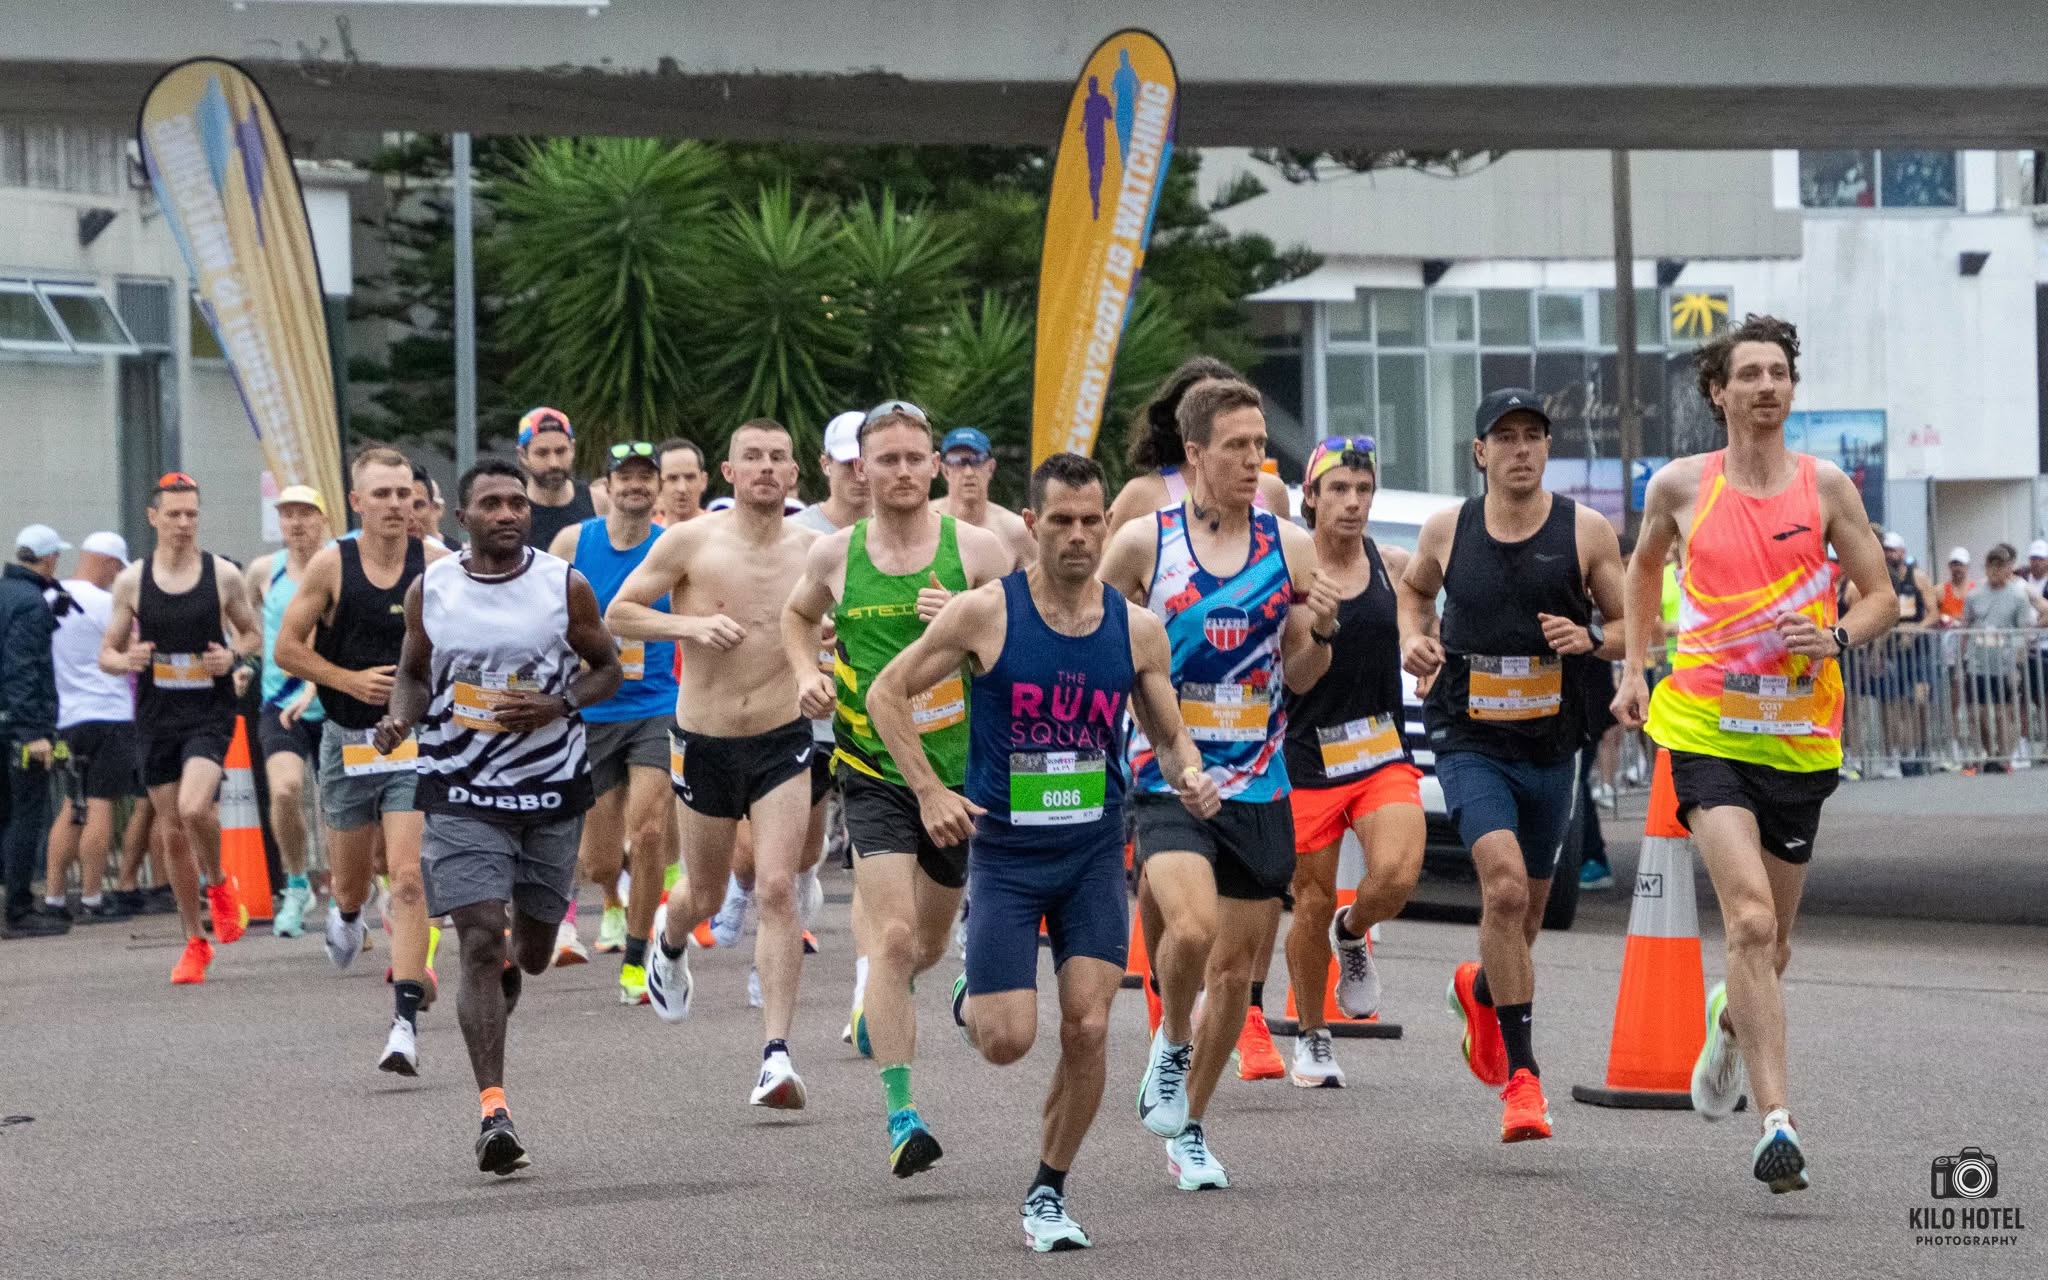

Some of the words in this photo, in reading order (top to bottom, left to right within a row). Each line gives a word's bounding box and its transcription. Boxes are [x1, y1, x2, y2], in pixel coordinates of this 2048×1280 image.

[1113, 81, 1170, 240] WATCHING
[1107, 243, 1134, 278] IS
[1067, 275, 1123, 456] EVERYBODY
[1057, 671, 1087, 685] THE
[1011, 682, 1121, 728] RUN
[448, 786, 562, 810] DUBBO
[1042, 789, 1081, 807] 6086
